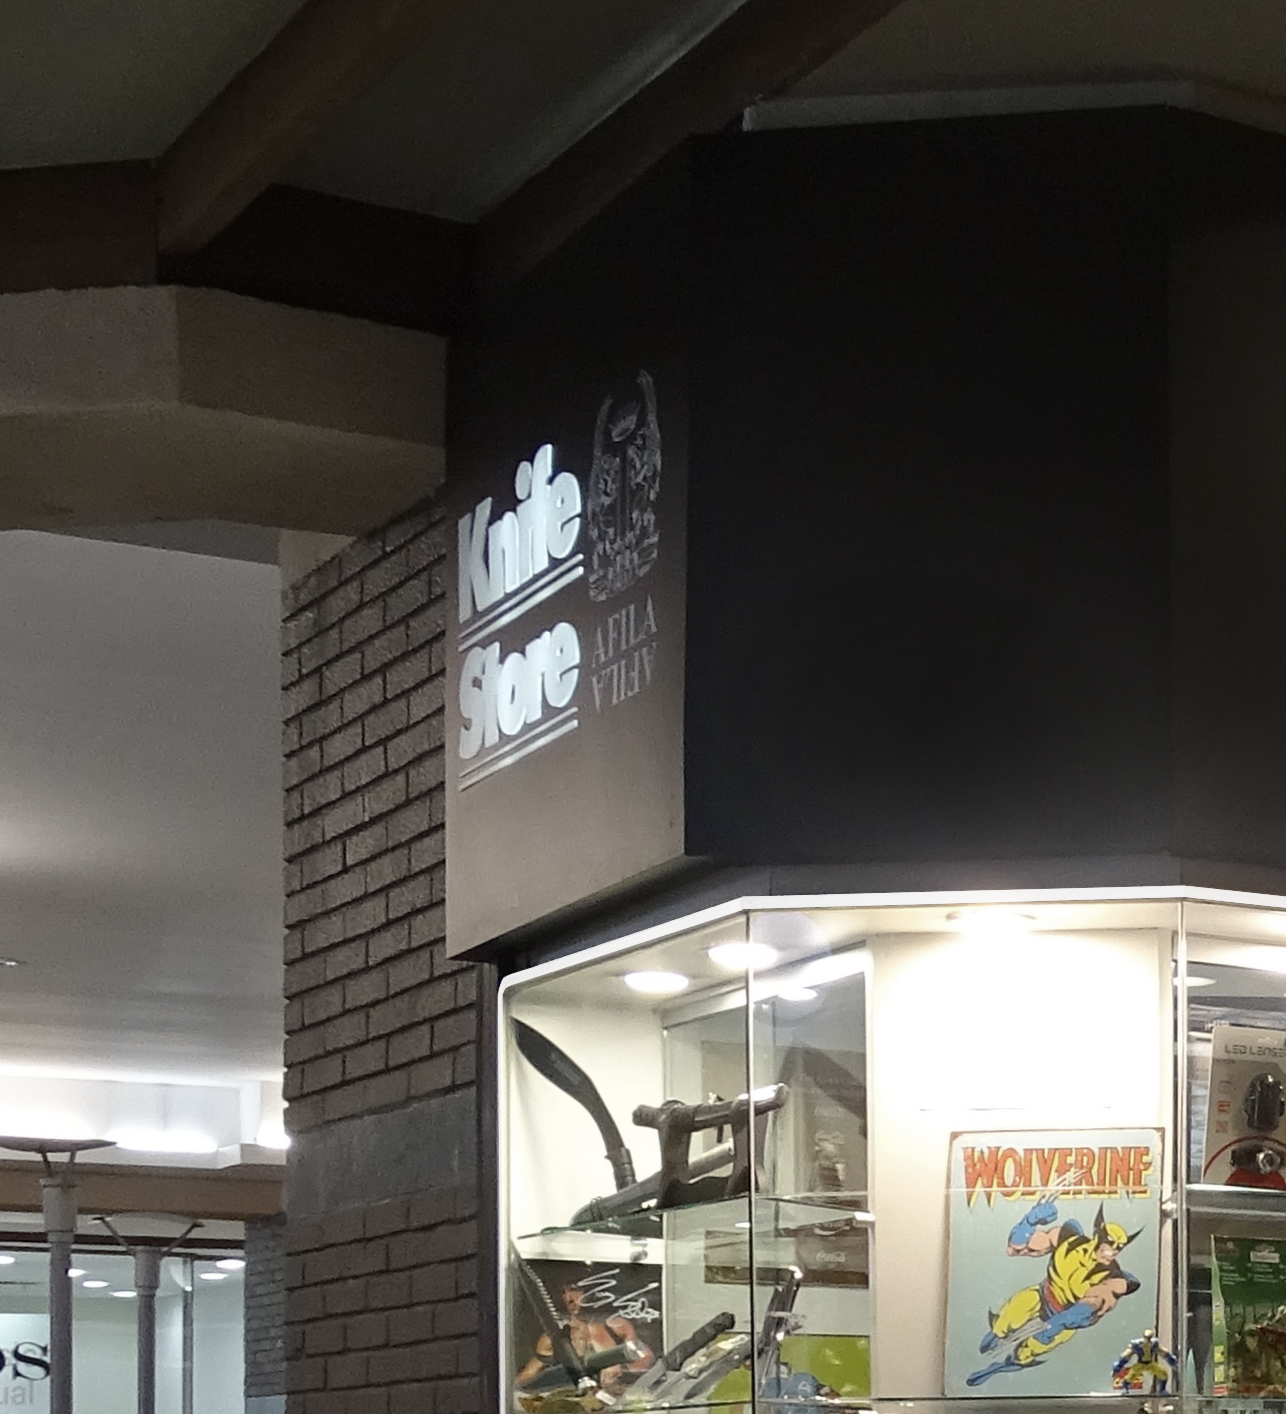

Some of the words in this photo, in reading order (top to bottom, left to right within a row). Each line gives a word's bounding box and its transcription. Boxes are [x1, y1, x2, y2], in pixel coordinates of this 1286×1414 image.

[457, 443, 582, 624] Knife
[591, 594, 657, 666] AFILA
[458, 621, 580, 760] Store
[1224, 1043, 1247, 1056] LED
[962, 1146, 1153, 1210] WOLVERINE
